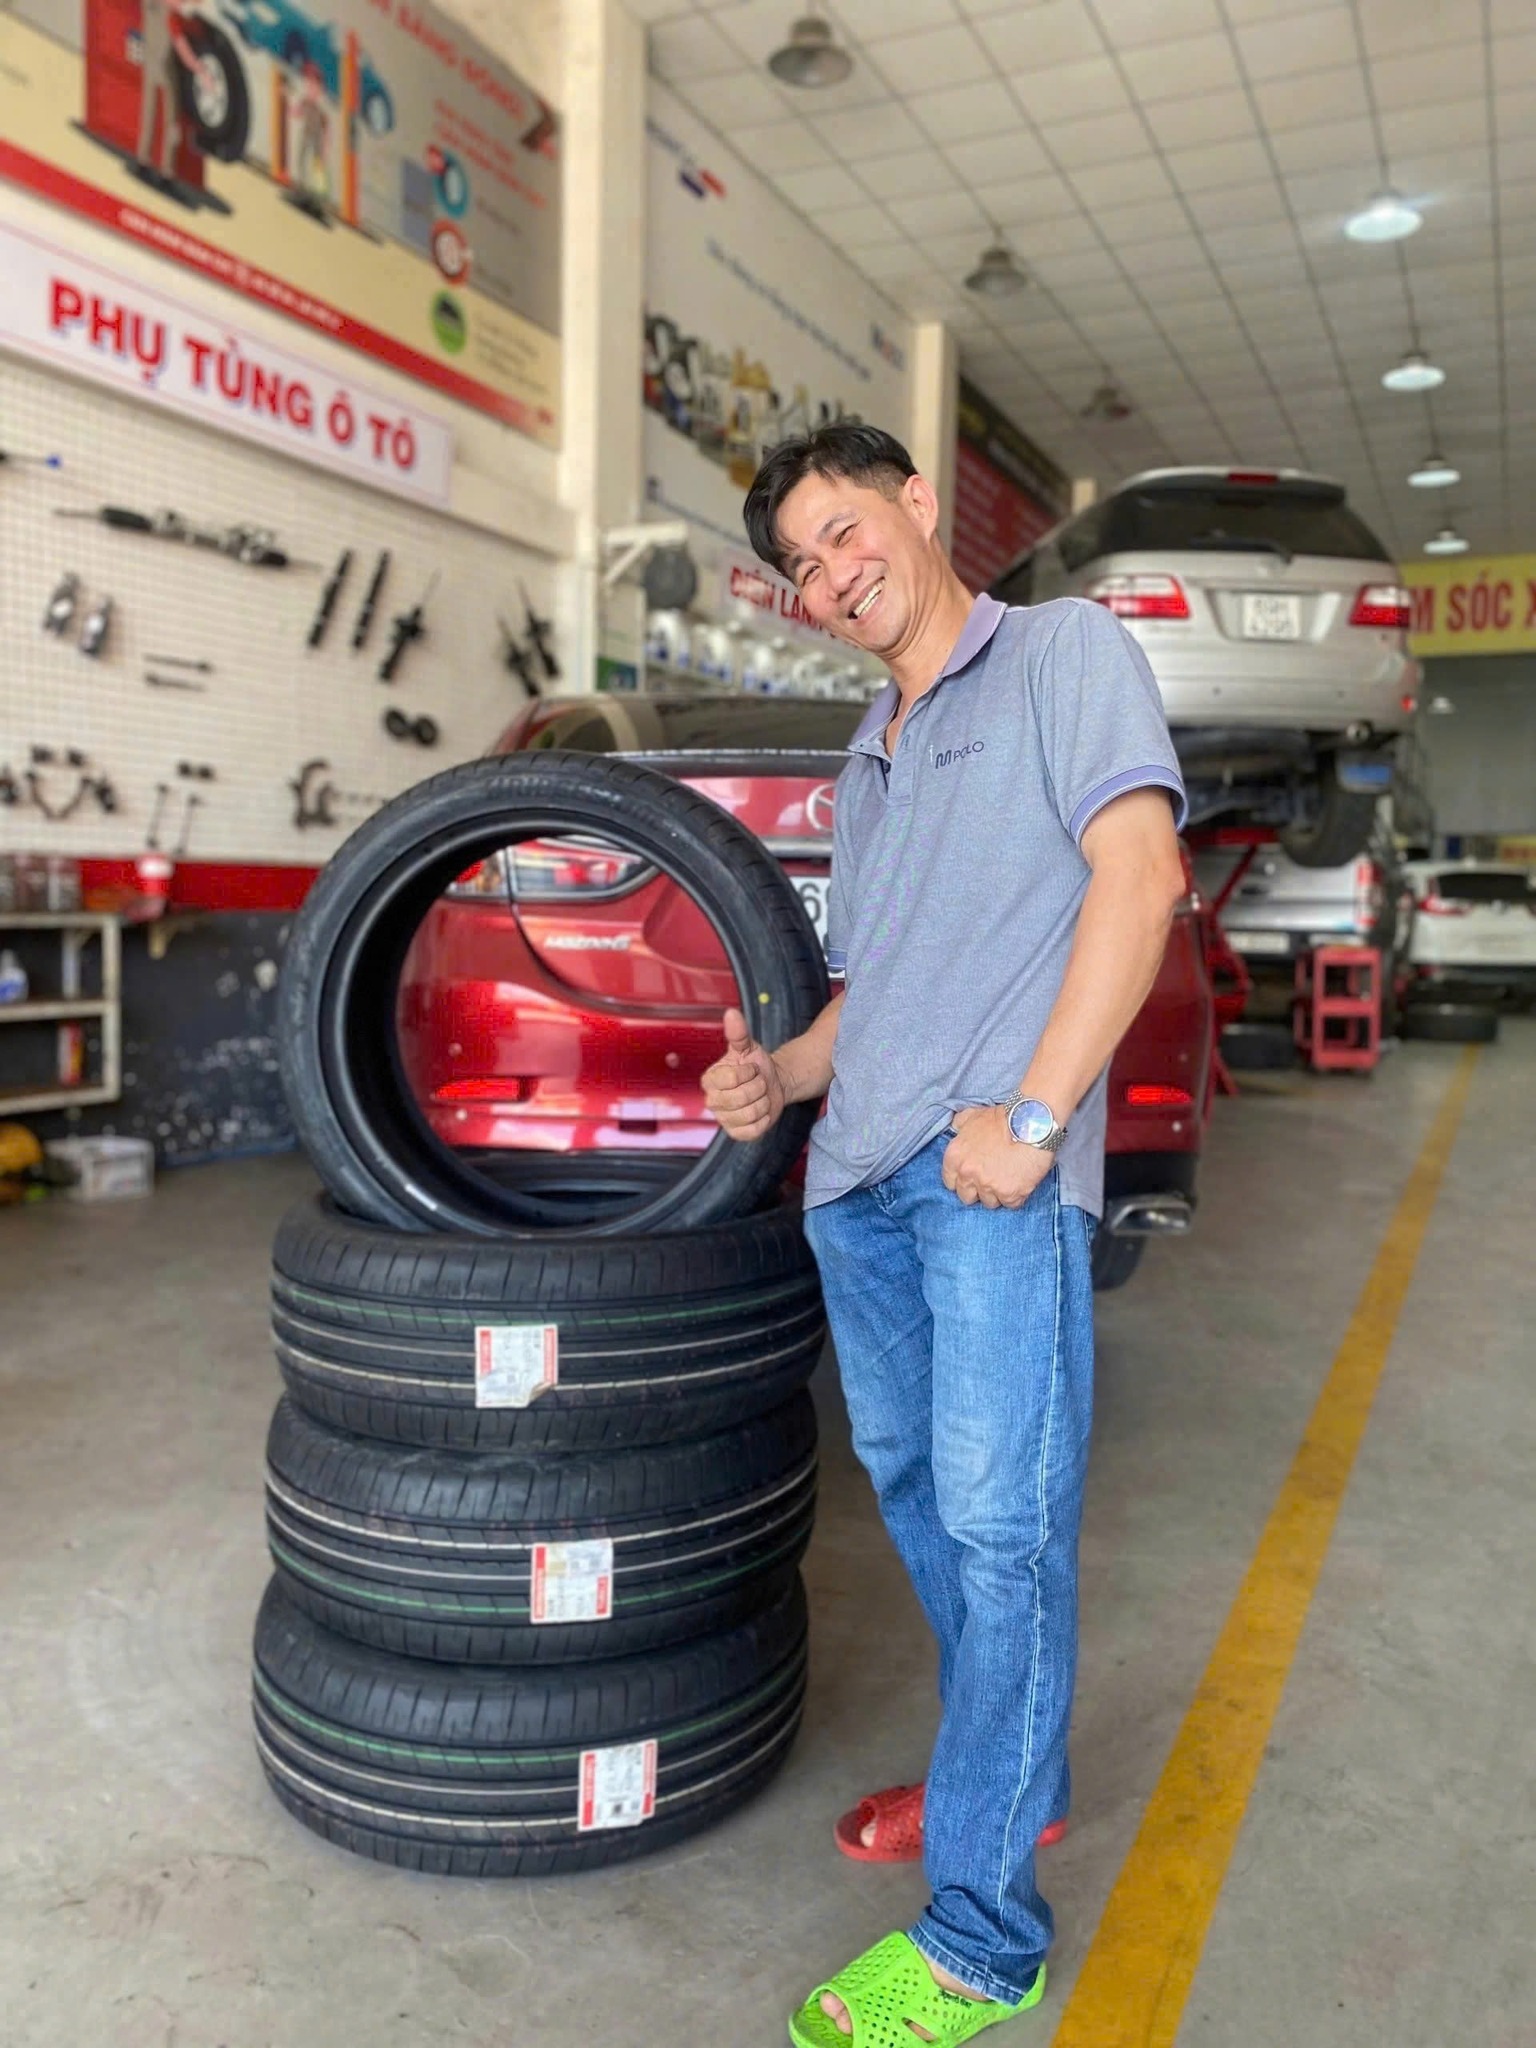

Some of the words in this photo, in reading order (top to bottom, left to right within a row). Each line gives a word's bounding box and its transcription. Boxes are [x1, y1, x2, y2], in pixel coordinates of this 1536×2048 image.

[50, 276, 165, 383] PHỤ
[184, 337, 313, 428] TÙNG
[327, 391, 355, 445] Ô
[367, 414, 416, 470] TÔ
[1447, 566, 1513, 634] SÓC
